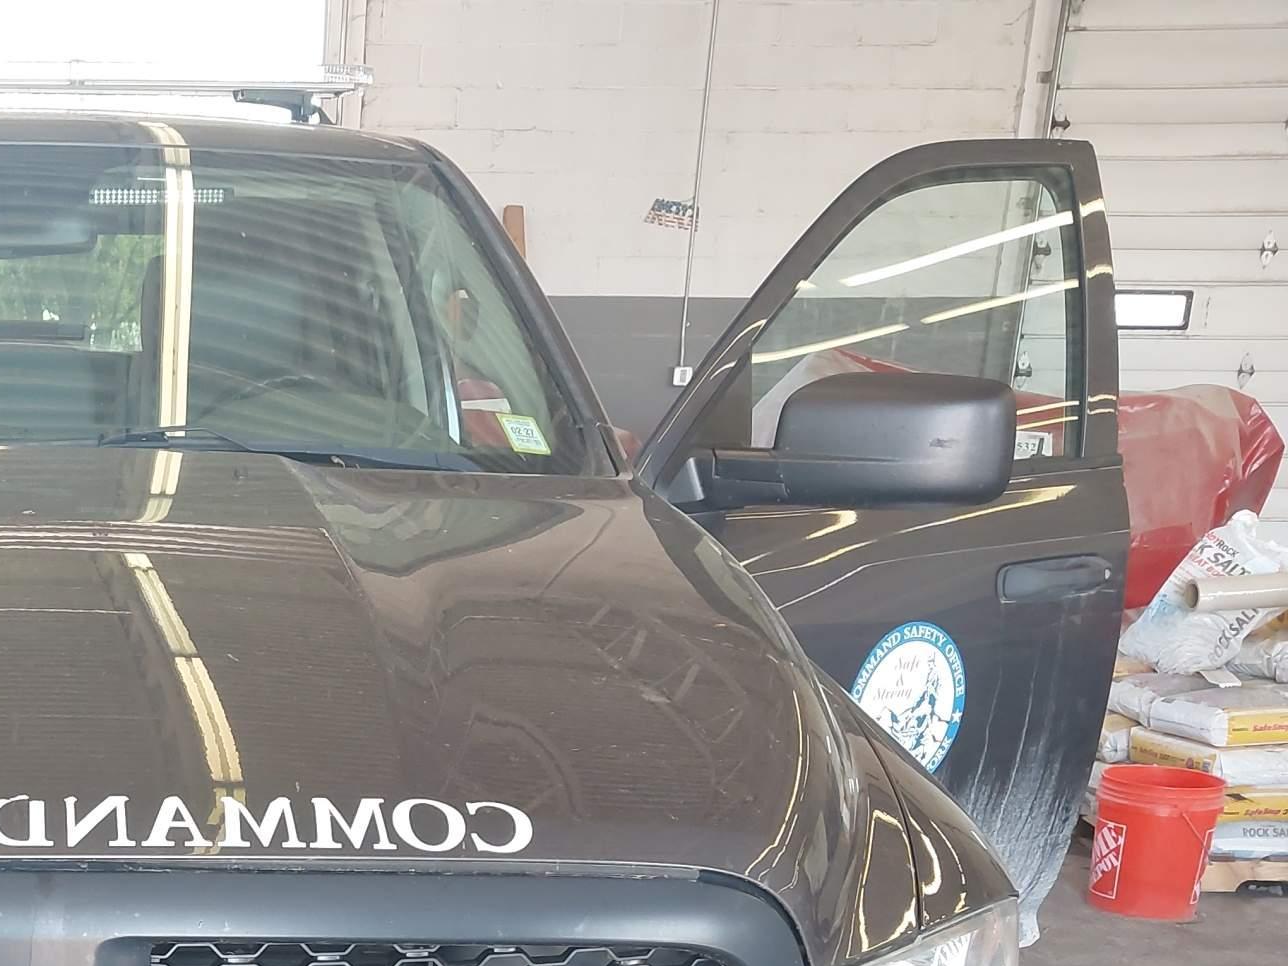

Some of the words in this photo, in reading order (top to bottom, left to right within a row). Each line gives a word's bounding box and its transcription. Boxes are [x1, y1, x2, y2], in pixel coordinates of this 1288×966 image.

[852, 631, 901, 699] OMMAND
[903, 625, 947, 648] SAFETY
[945, 644, 965, 696] OFFICE
[1243, 827, 1270, 838] ROCK
